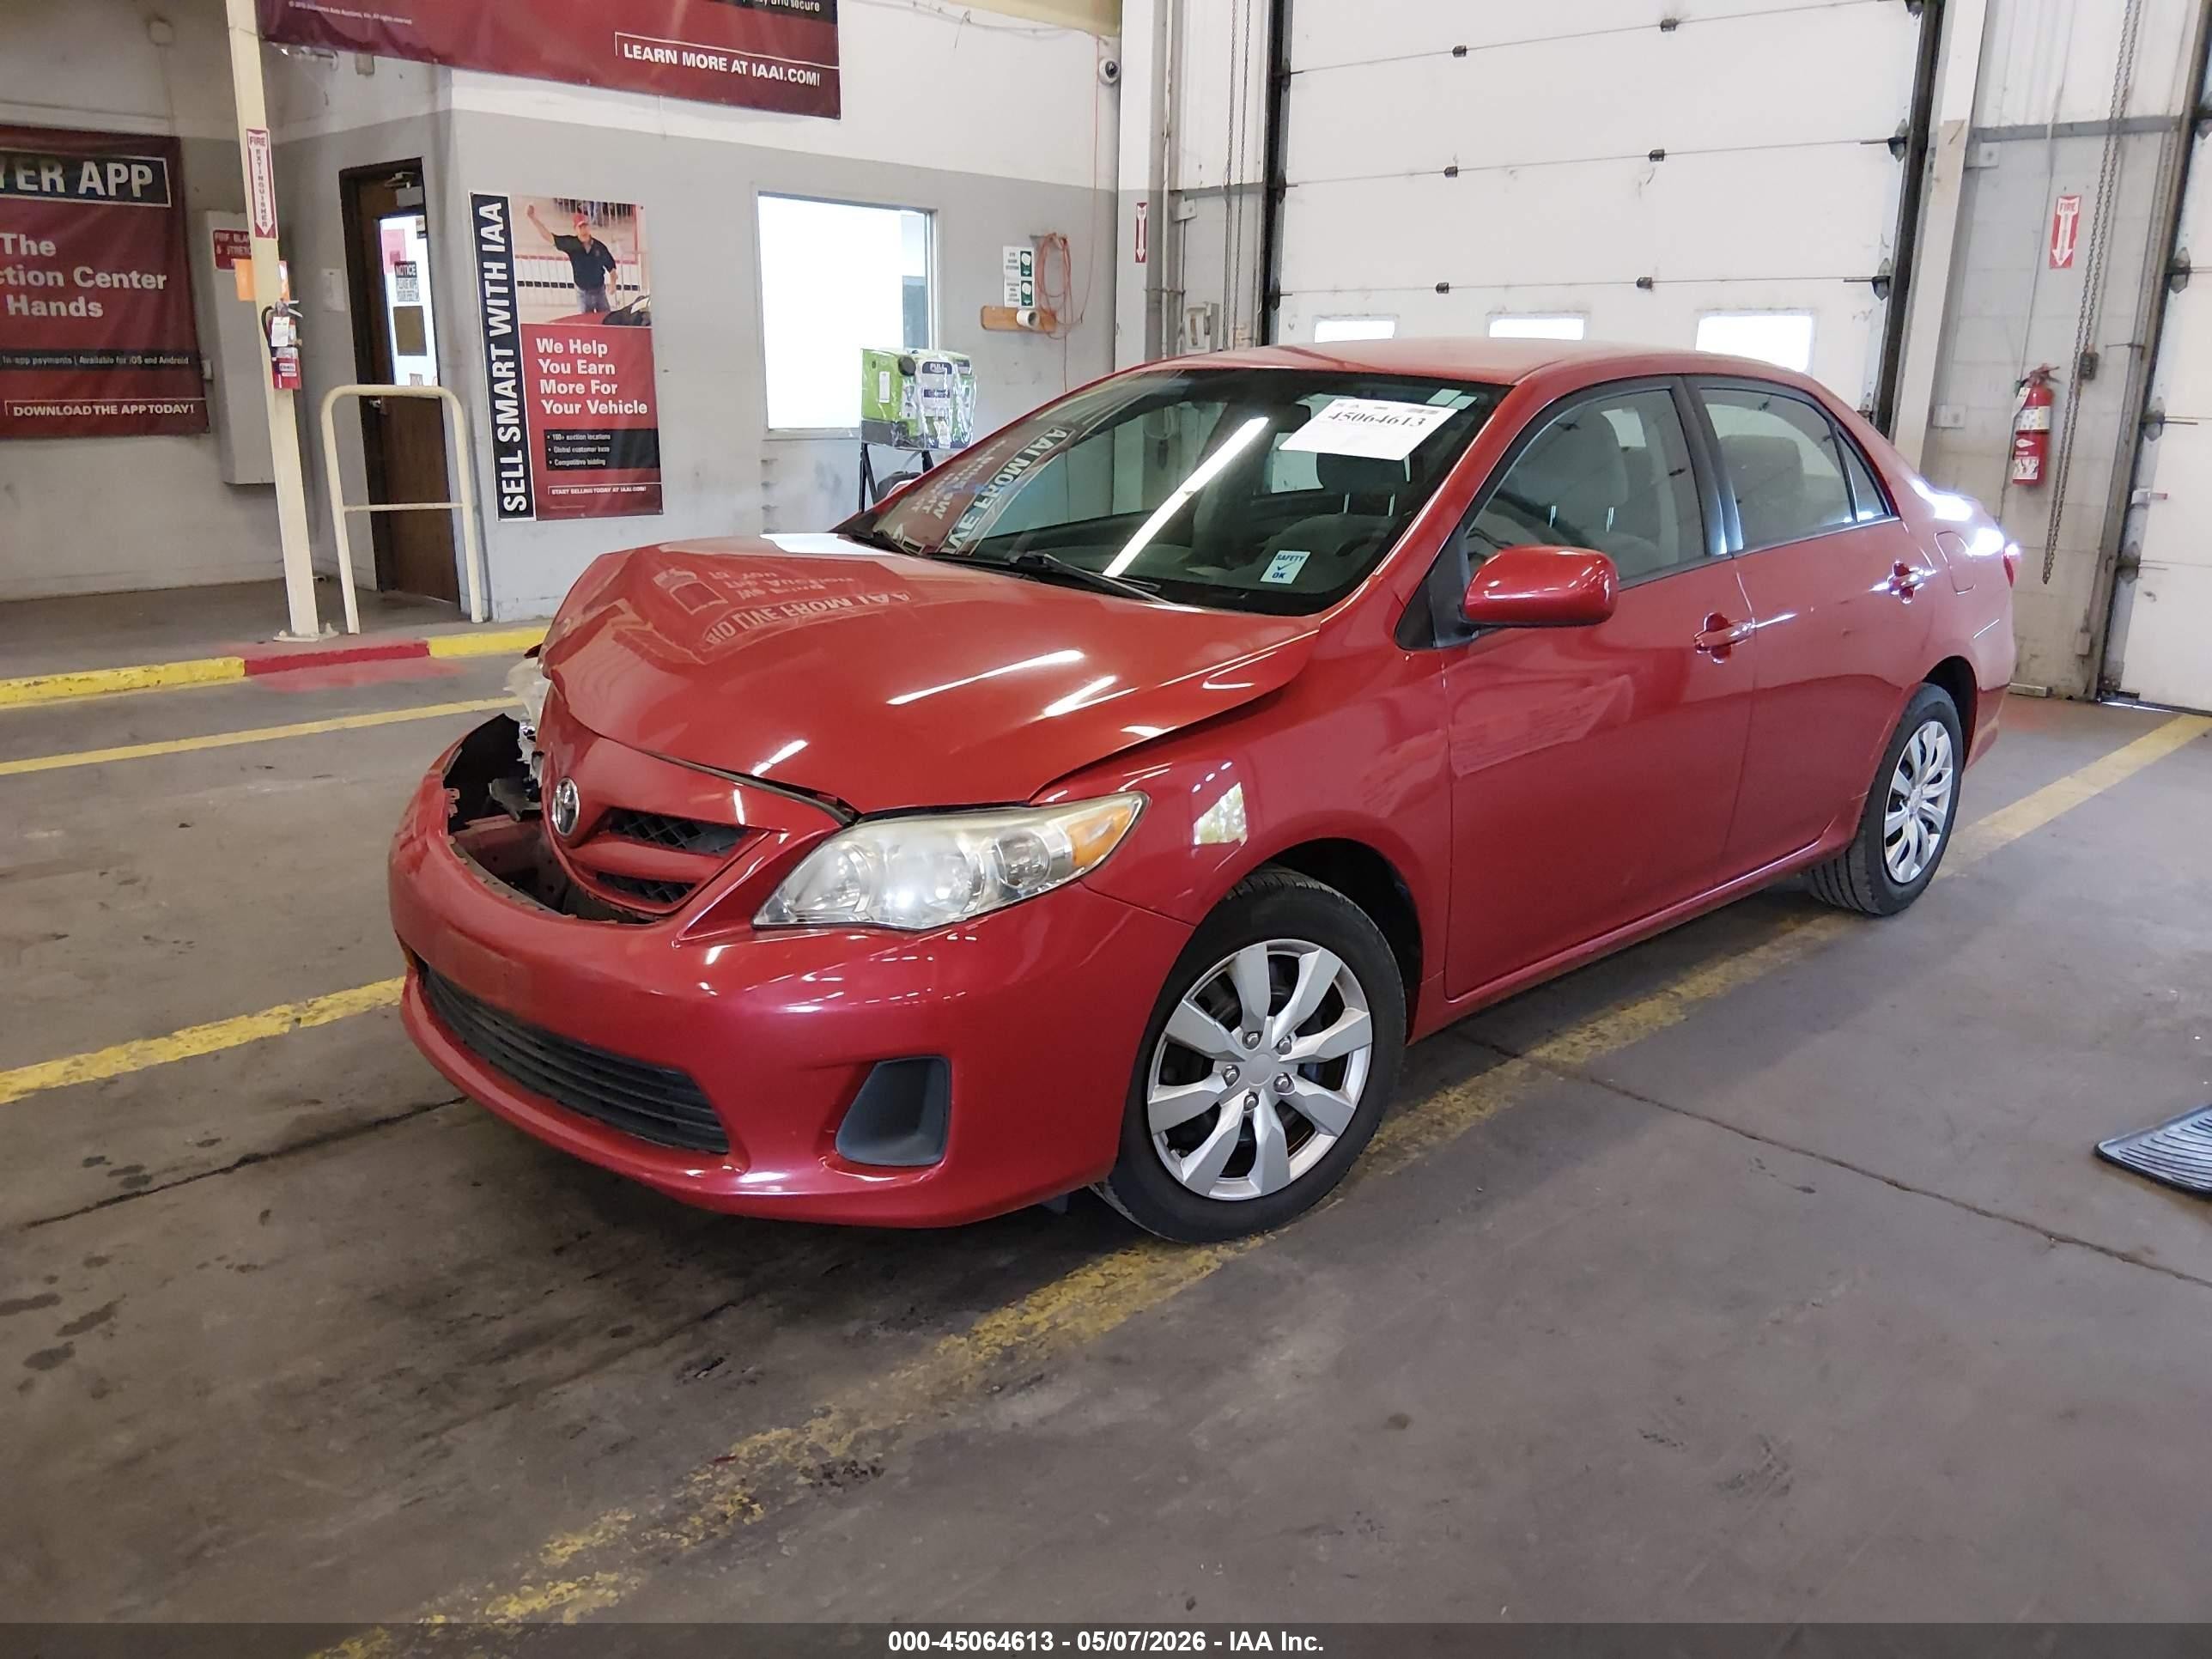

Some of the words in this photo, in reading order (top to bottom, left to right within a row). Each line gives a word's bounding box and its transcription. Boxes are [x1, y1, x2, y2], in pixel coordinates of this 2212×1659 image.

[623, 43, 678, 64] LEARN
[682, 52, 727, 72] MORE
[731, 58, 749, 76] AT
[752, 63, 820, 87] IAAI.COM!
[249, 137, 266, 147] FIRE
[78, 161, 154, 198] APP
[256, 149, 268, 228] EXTINGUISHER
[478, 203, 506, 252] IAA
[0, 233, 57, 257] The
[73, 266, 167, 289] Center
[395, 264, 416, 276] NOTICE
[6, 295, 104, 318] Hands
[483, 262, 513, 337] WITH
[536, 337, 564, 354] We
[568, 338, 608, 358] Help
[33, 356, 72, 367] payments
[79, 356, 114, 365] Available
[116, 356, 127, 365] for
[144, 356, 157, 365] and
[159, 356, 189, 365] Android
[538, 359, 571, 374] You
[577, 359, 616, 375] Earn
[489, 343, 522, 444] SMART
[540, 379, 586, 394] More
[591, 380, 618, 394] For
[13, 405, 92, 416] DOWNLOAD
[92, 404, 118, 415] THE
[121, 404, 147, 415] APP
[147, 404, 195, 415] TODAY!
[541, 399, 581, 415] Your
[586, 399, 647, 415] Vehicle
[1328, 410, 1426, 428] 45064613
[499, 449, 527, 513] SELL
